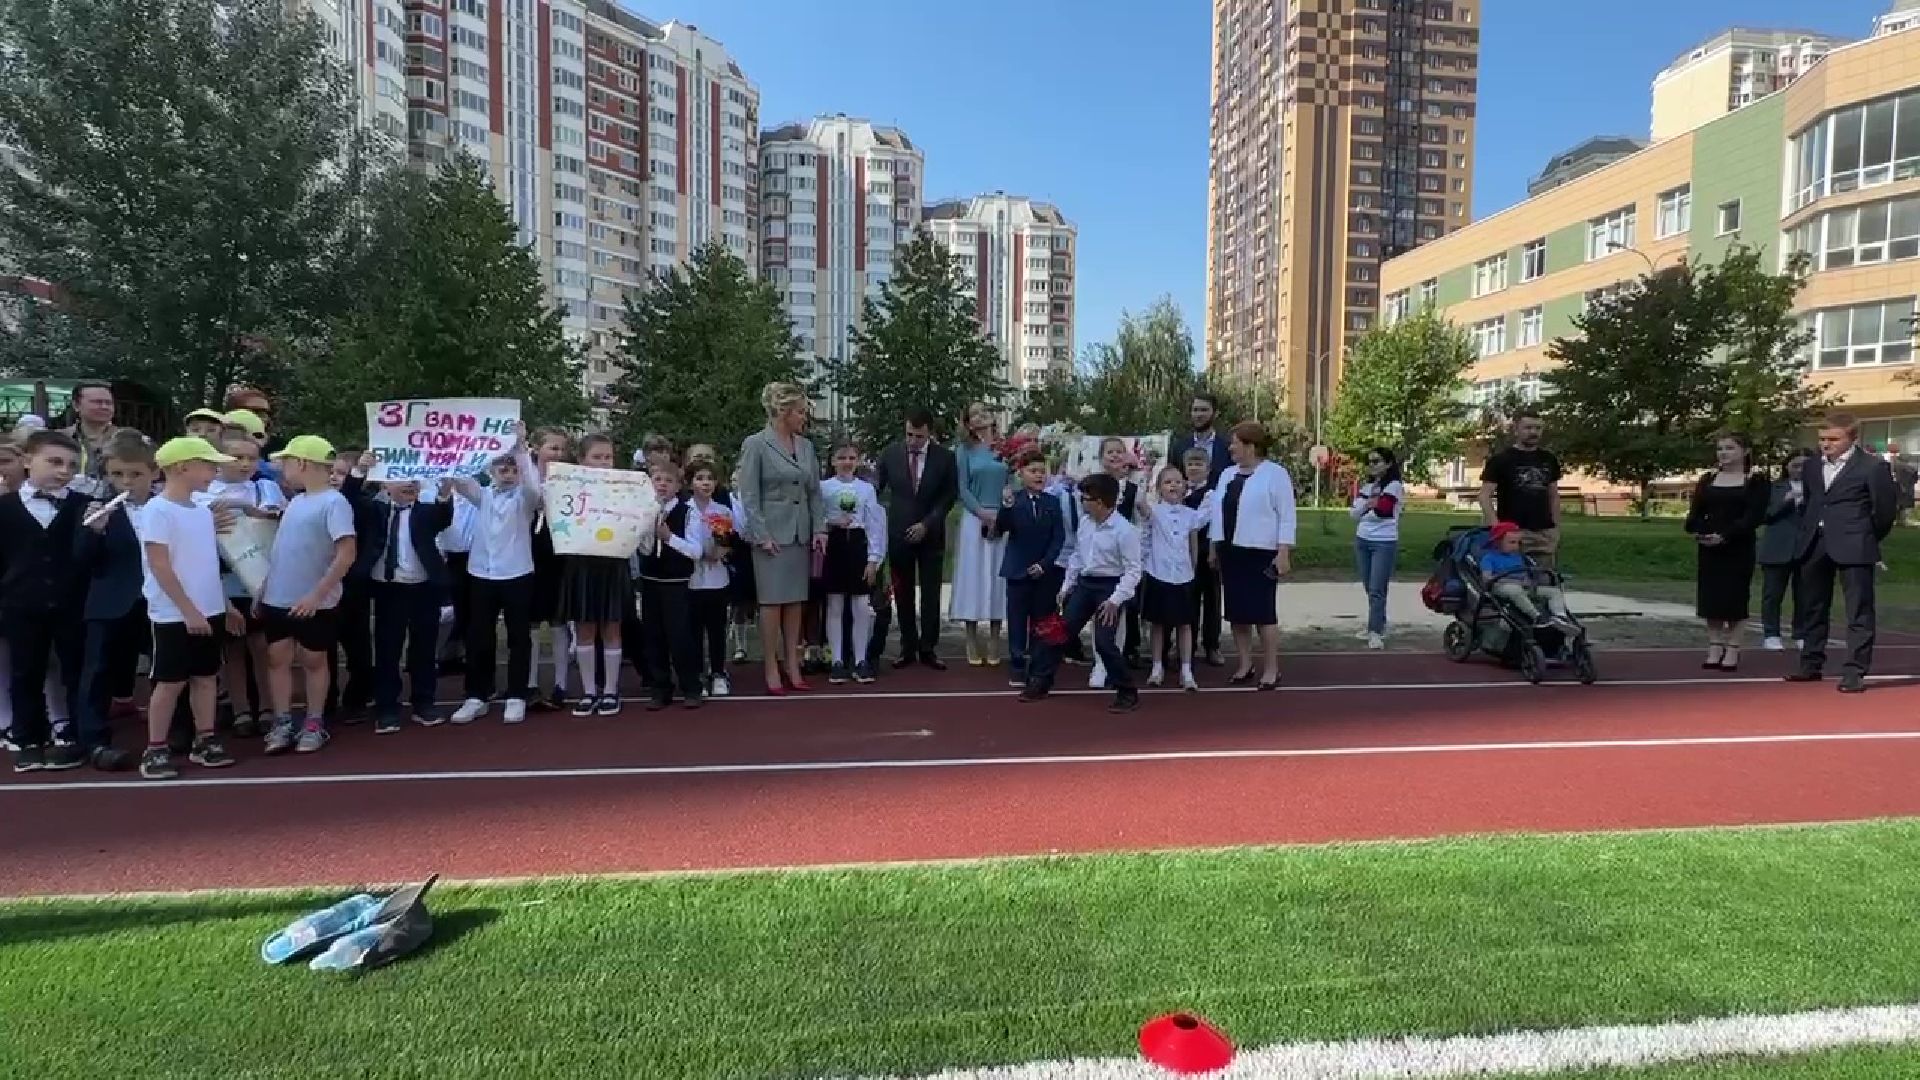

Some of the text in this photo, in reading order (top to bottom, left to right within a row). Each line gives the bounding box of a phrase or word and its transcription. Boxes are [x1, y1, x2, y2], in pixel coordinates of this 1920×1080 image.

[425, 411, 476, 431] ВАМ
[483, 417, 517, 435] НЕ
[408, 430, 502, 451] СЛОМИТЬ
[373, 447, 421, 464] БИЛИ
